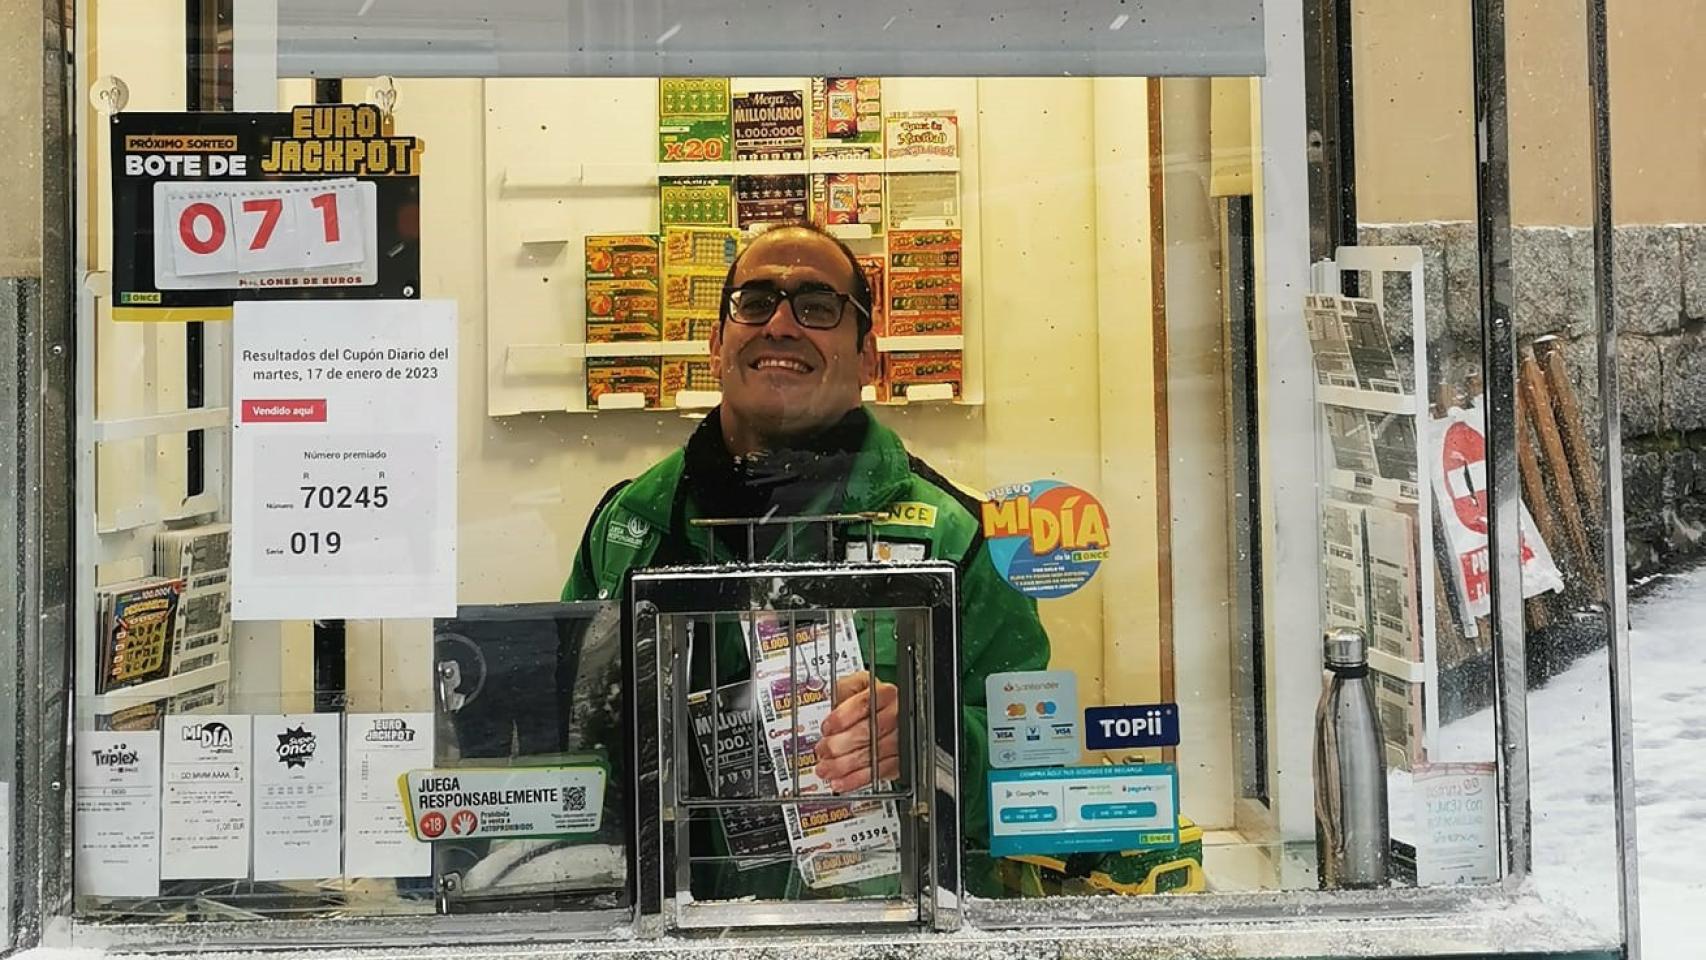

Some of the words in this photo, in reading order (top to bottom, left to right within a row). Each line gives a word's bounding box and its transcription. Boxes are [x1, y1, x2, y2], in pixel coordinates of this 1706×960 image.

[293, 106, 379, 137] EURO
[735, 106, 802, 123] MILLONARIO
[129, 137, 184, 149] PRÓXIMO
[187, 138, 234, 150] SORTEO
[261, 139, 414, 174] JACKPOT
[125, 155, 201, 176] BOTE
[209, 155, 247, 176] DE
[179, 193, 340, 254] 071
[302, 277, 321, 285] DE
[323, 276, 362, 284] EUROS
[243, 349, 316, 361] Resultados
[320, 348, 339, 361] del
[342, 349, 384, 364] Cupón
[387, 347, 426, 361] Diario
[429, 347, 449, 360] del
[253, 369, 303, 382] martes,
[307, 368, 323, 380] 17
[326, 368, 343, 380] de
[346, 370, 382, 380] enero
[385, 367, 402, 379] de
[405, 367, 438, 379] 2023
[252, 406, 291, 416] Vendido
[293, 406, 314, 418] aquí
[304, 450, 341, 460] Número
[343, 450, 387, 461] premiado
[300, 485, 388, 509] 70245
[985, 484, 1032, 501] NUEVO
[887, 503, 928, 521] NCE
[982, 495, 1029, 538] MI
[1030, 495, 1110, 556] DÍA
[290, 532, 341, 555] 019
[182, 724, 202, 741] MI
[418, 777, 461, 793] JUEGA
[419, 788, 558, 809] RESPONSABLEMENTE
[851, 826, 889, 843] 05394
